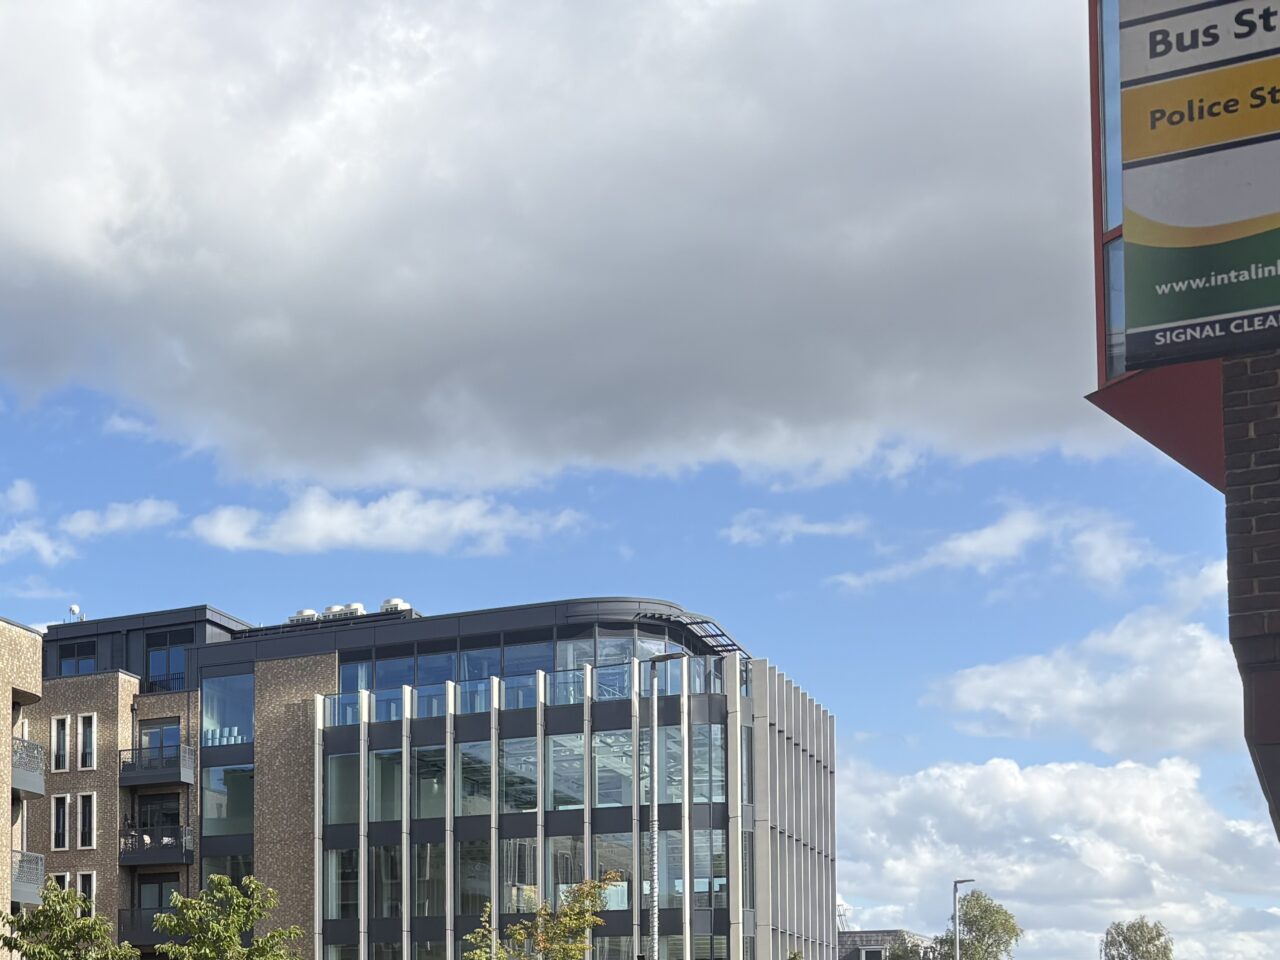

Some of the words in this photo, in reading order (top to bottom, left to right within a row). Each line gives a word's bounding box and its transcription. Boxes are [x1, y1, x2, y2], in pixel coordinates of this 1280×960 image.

[1149, 24, 1220, 59] Bus
[1234, 6, 1278, 39] St
[1150, 98, 1239, 130] Police
[1154, 323, 1226, 346] SIGNAL
[1230, 314, 1280, 334] CLEA
